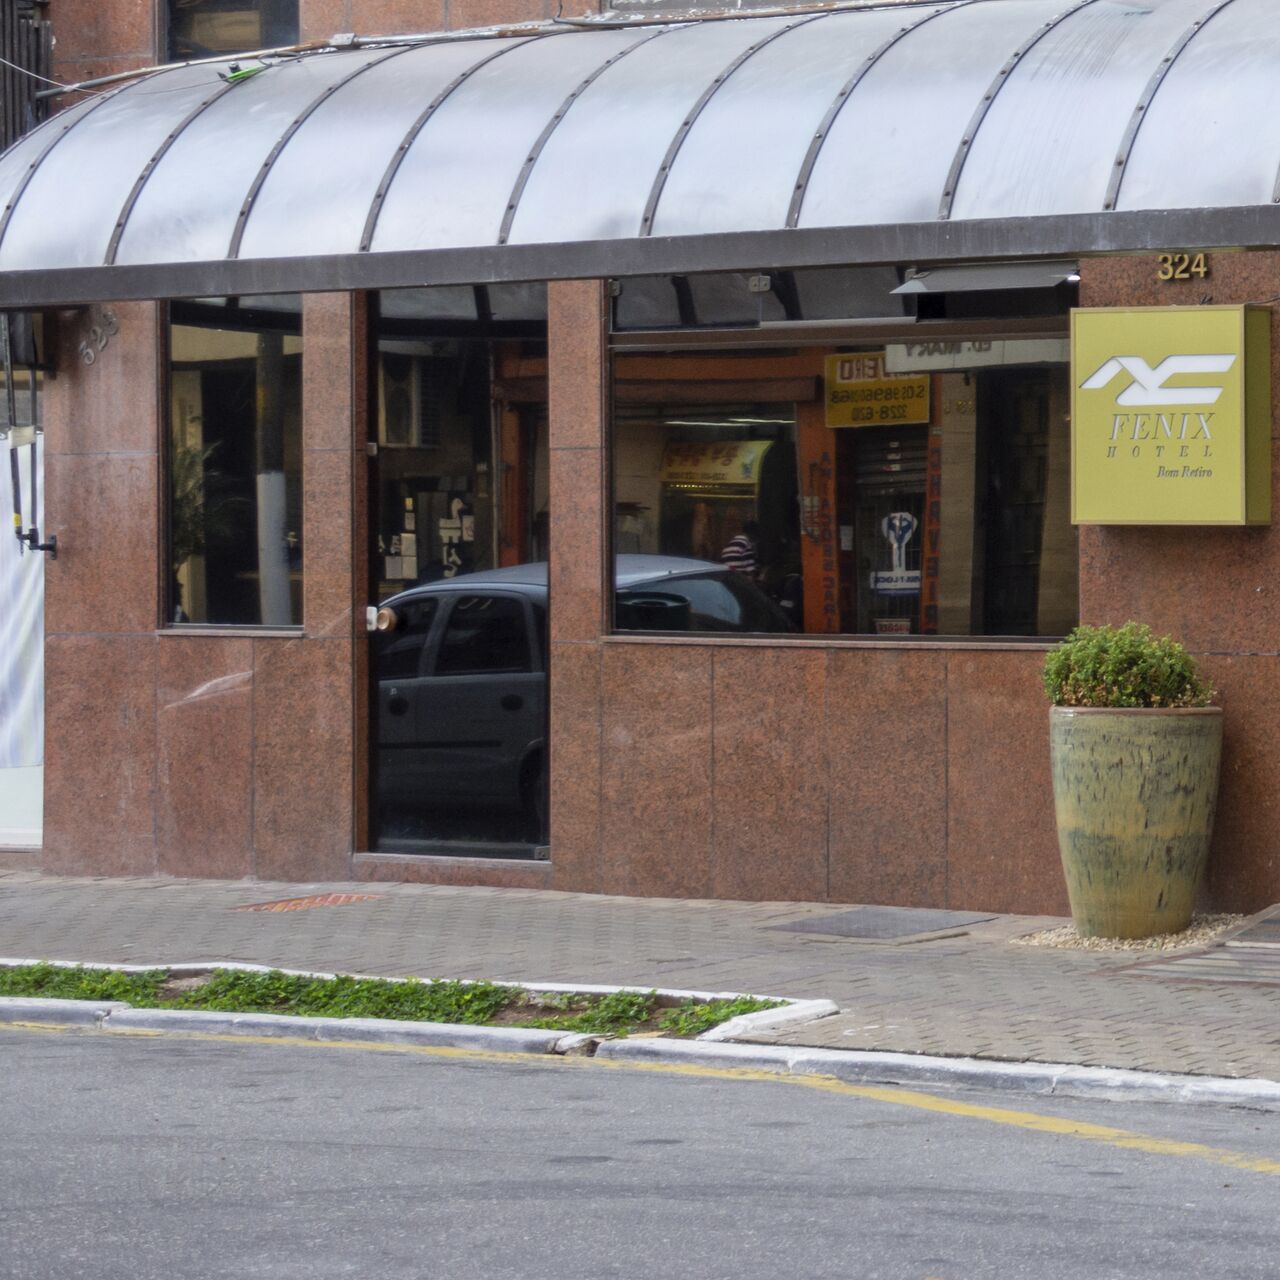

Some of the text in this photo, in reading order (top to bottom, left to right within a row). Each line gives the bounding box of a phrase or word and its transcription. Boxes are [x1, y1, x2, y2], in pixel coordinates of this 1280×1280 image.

[1157, 254, 1207, 279] 324
[1109, 412, 1216, 440] FENIX
[1106, 445, 1213, 458] HOTEL
